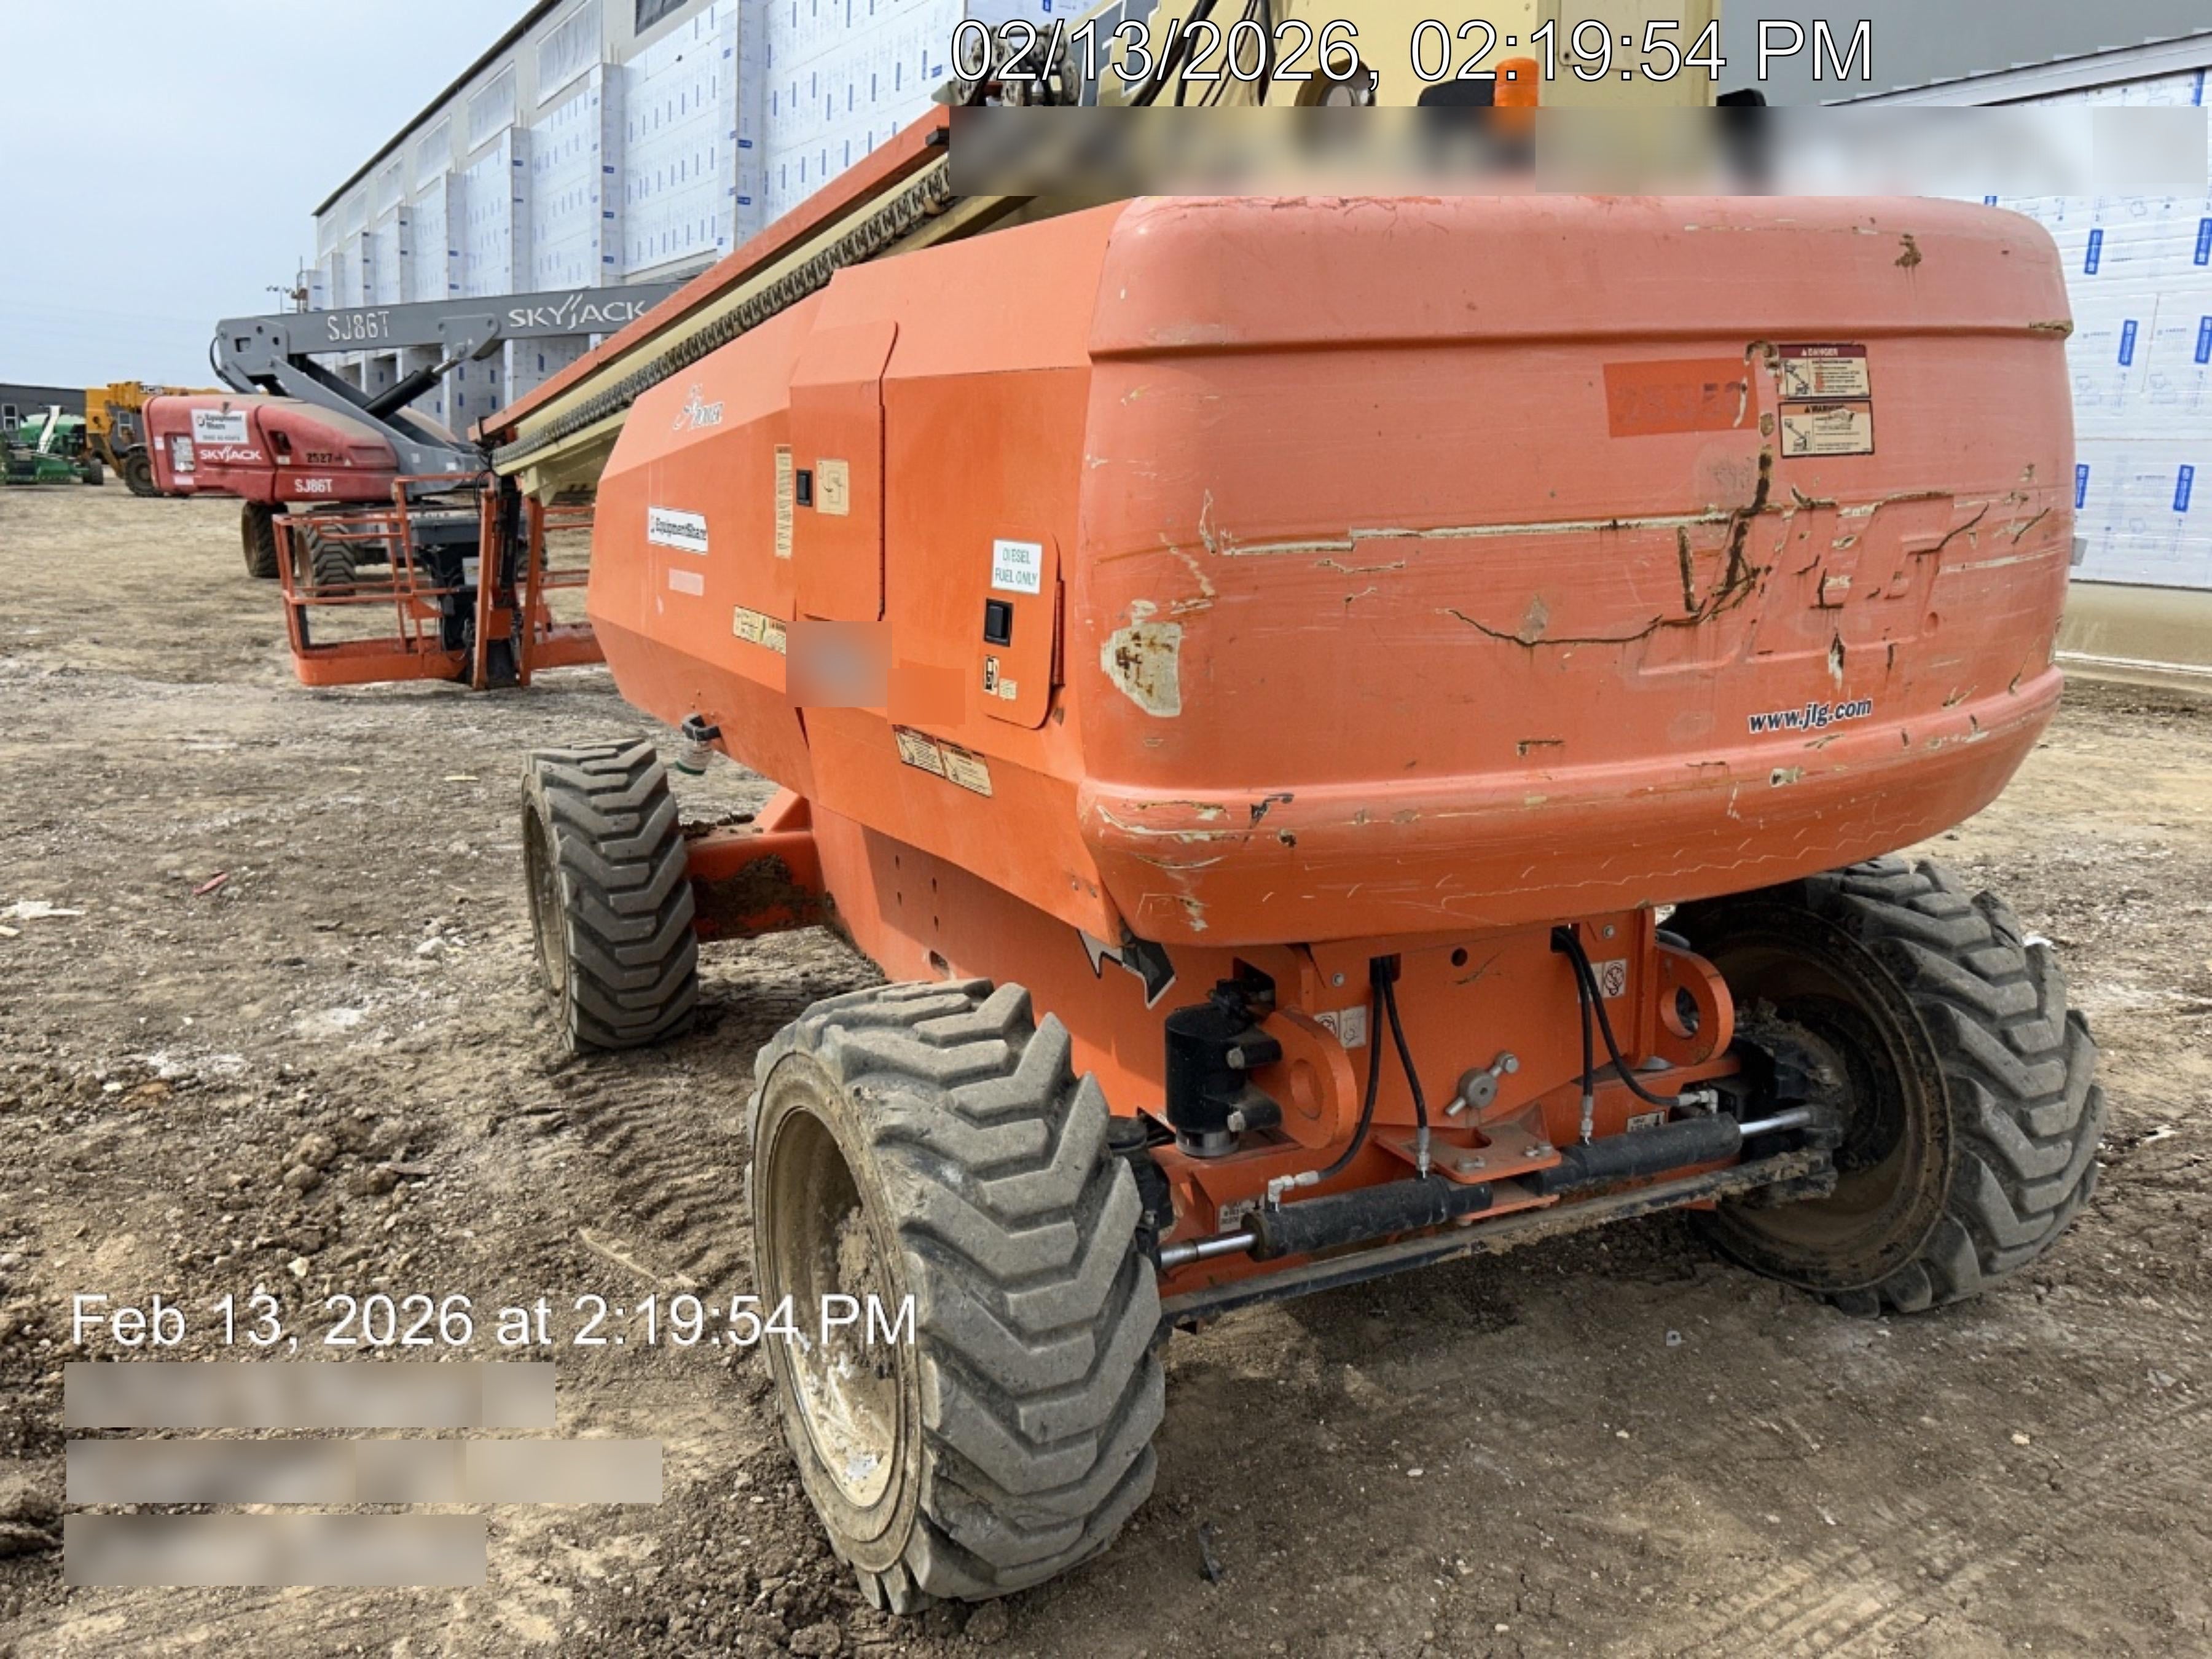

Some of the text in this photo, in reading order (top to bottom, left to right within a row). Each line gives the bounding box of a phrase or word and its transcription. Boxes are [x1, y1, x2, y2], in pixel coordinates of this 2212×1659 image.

[508, 293, 646, 330] SKYJACK
[327, 310, 390, 341] SJ86T
[1808, 348, 1838, 356] DANGER
[200, 445, 262, 461] SKYJACK
[295, 479, 332, 493] SJ86T
[1002, 547, 1031, 565] DIESEL
[995, 567, 1038, 586] FUEL ONLY
[1749, 699, 1872, 731] www.jlg.com
